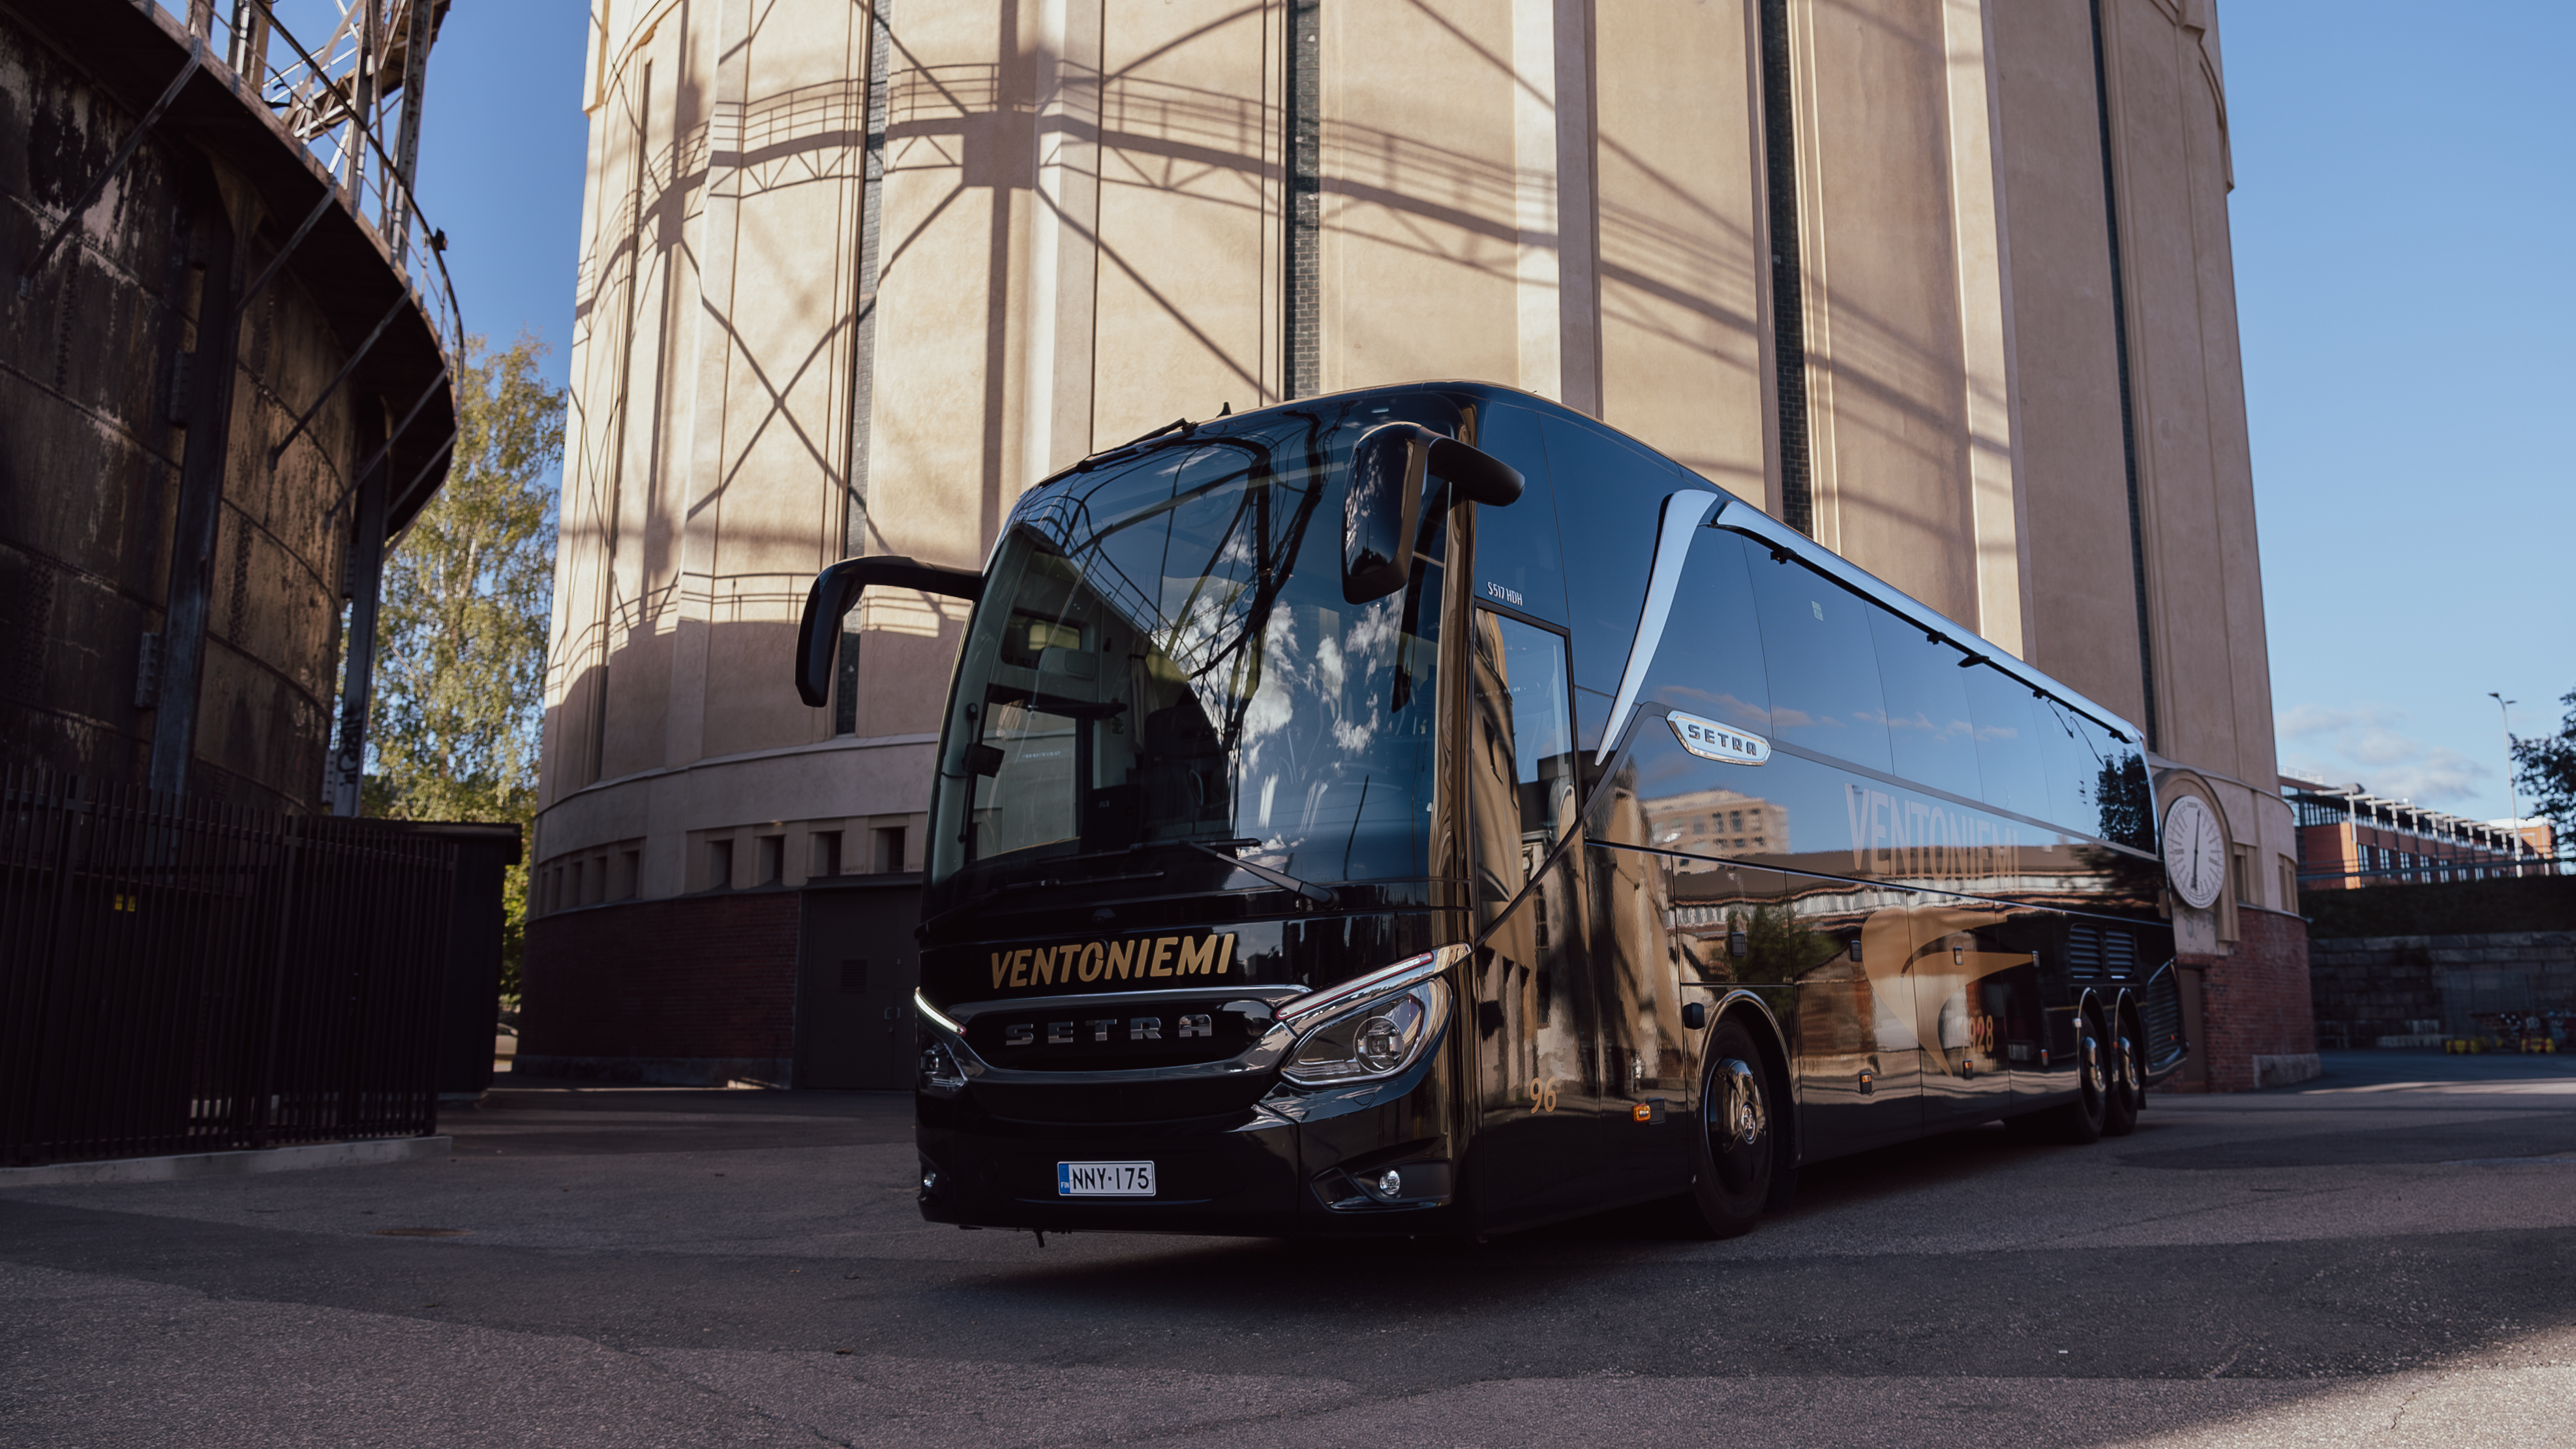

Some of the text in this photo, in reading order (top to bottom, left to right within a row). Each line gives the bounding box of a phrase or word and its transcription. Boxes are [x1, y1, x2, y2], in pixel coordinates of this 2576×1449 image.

[1506, 588, 1523, 606] HDH
[1688, 724, 1756, 755] SETRA
[1845, 783, 2019, 894] VENTONIEMI
[991, 934, 1234, 988] VENTONIEMI
[1006, 1014, 1212, 1045] SETRA
[1961, 1015, 1993, 1057] 1928
[1530, 1076, 1556, 1114] 96
[1072, 1167, 1149, 1189] NNY-175
